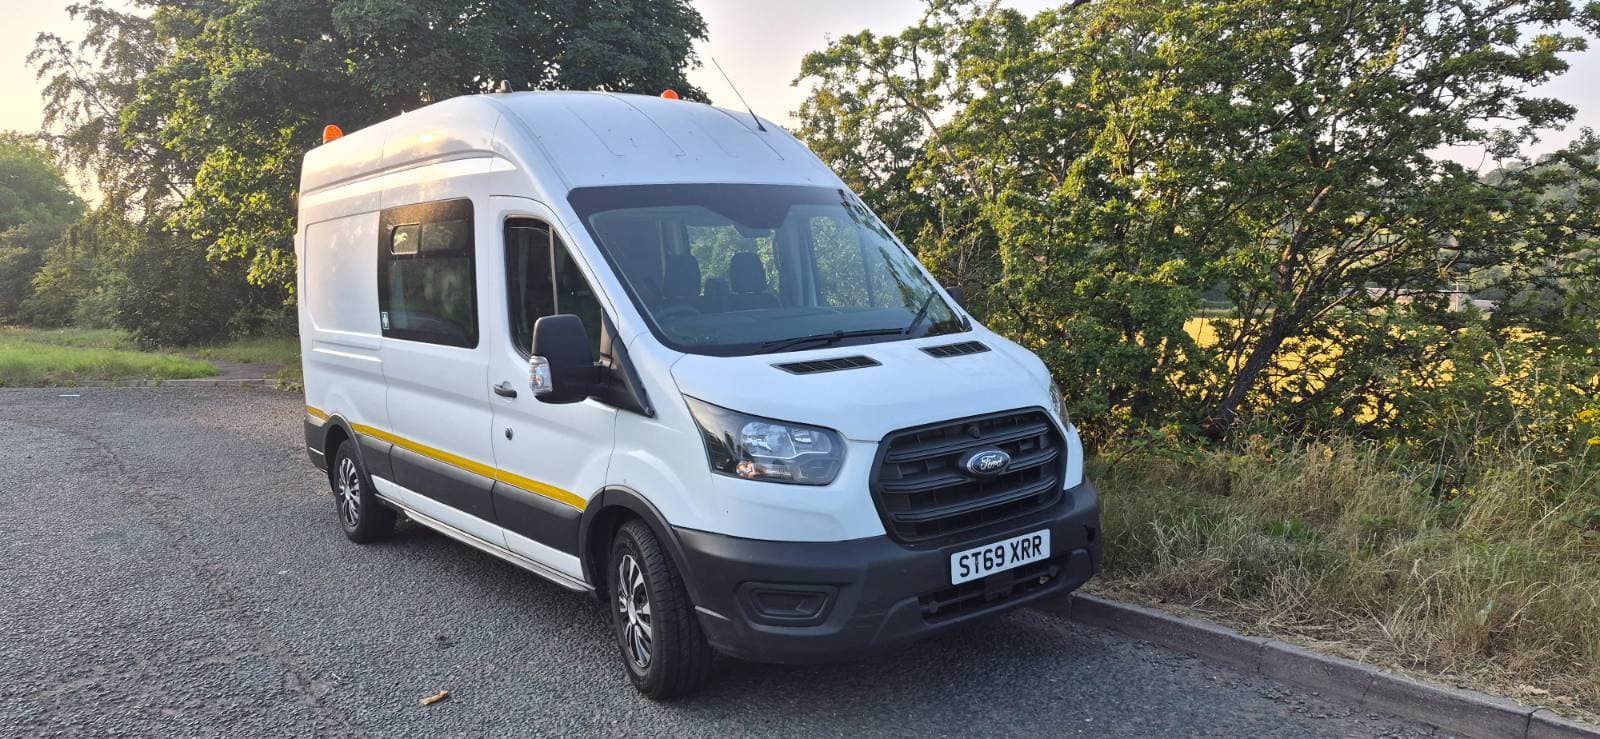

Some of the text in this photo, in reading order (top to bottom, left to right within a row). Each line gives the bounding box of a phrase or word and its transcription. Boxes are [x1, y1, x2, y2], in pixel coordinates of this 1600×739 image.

[980, 454, 1003, 470] Ford
[959, 535, 1042, 578] ST69 XRR
